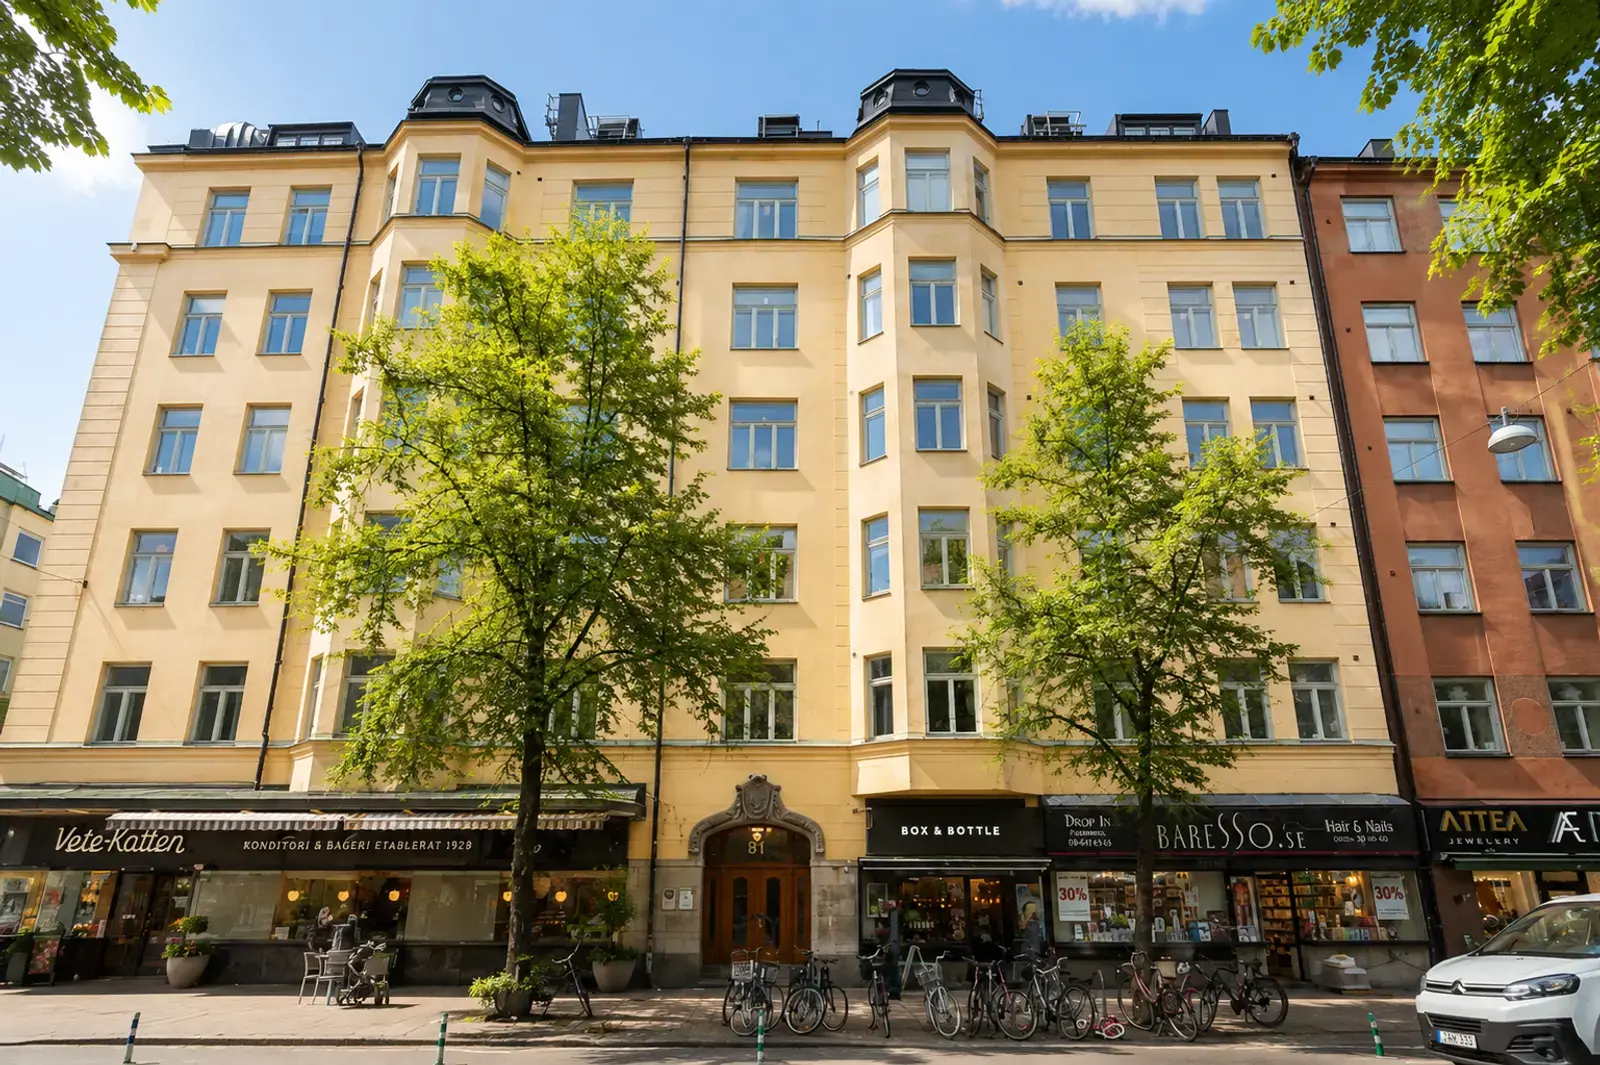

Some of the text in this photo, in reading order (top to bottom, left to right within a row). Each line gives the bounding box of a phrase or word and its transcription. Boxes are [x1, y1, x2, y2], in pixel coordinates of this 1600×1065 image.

[1324, 819, 1350, 833] Hair
[1365, 819, 1394, 833] Nails
[1440, 810, 1528, 832] ATTEA
[901, 826, 1000, 836] BOX & BOTTLE
[55, 827, 185, 854] Vete-Katten
[243, 840, 472, 850] KONDITORI & BAGERI ETABLERAT 1928
[748, 841, 765, 855] 81
[1059, 887, 1087, 901] 30%
[1375, 886, 1404, 900] 30%
